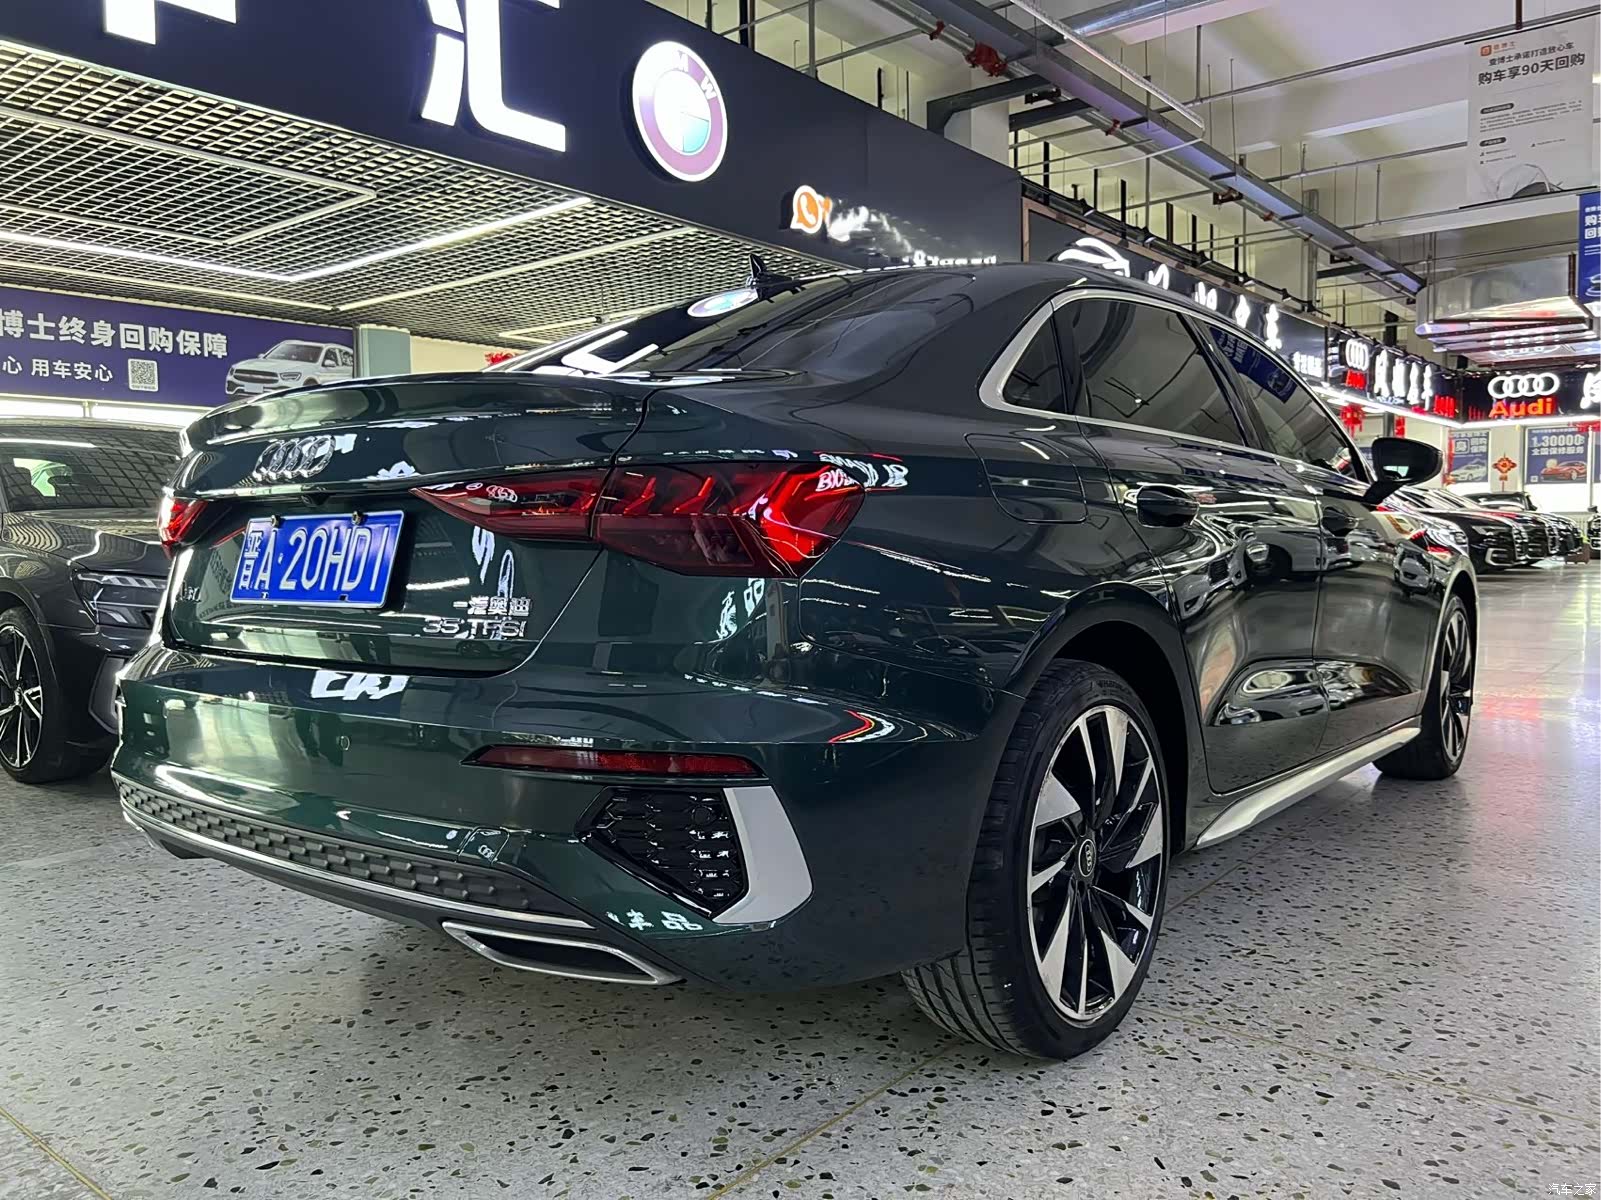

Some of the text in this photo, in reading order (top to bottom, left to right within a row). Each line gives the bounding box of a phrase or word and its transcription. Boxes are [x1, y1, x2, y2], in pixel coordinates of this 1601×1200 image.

[1477, 52, 1586, 86] 购车享90天回购
[0, 308, 228, 358] 博士终身回购保障
[31, 358, 113, 382] 用车安心
[1489, 397, 1553, 418] Audi
[467, 618, 527, 638] TFSI
